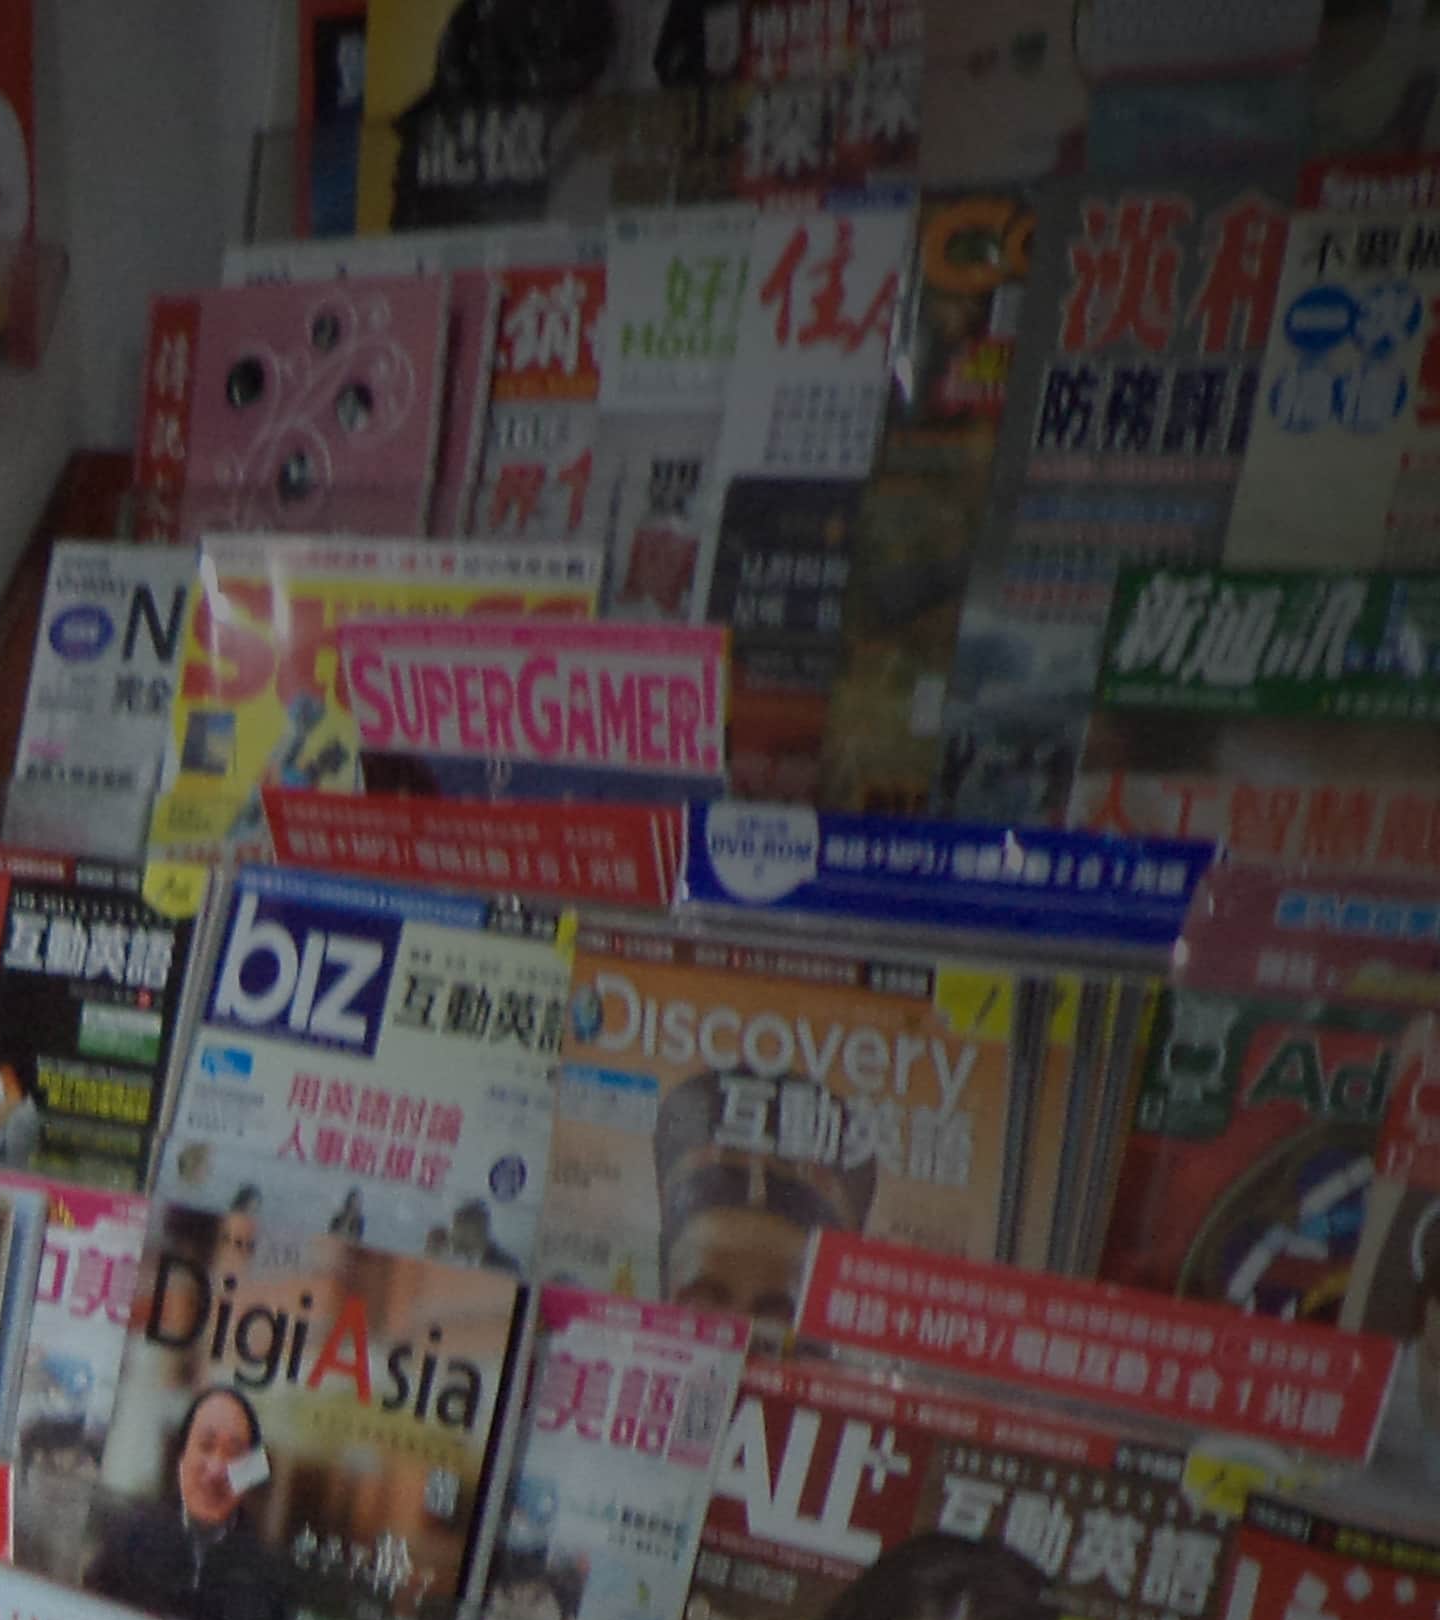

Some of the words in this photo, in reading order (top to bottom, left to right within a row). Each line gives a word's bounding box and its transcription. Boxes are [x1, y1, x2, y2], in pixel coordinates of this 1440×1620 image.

[346, 648, 721, 774] SUPERGAMER!
[3, 910, 176, 992] 互動英語
[592, 970, 977, 1117] Discovery
[288, 1074, 465, 1148] 用英語討論
[714, 1080, 973, 1188] 互動英語
[145, 1255, 481, 1433] DigiAsia
[937, 1468, 1224, 1612] 互動英語
